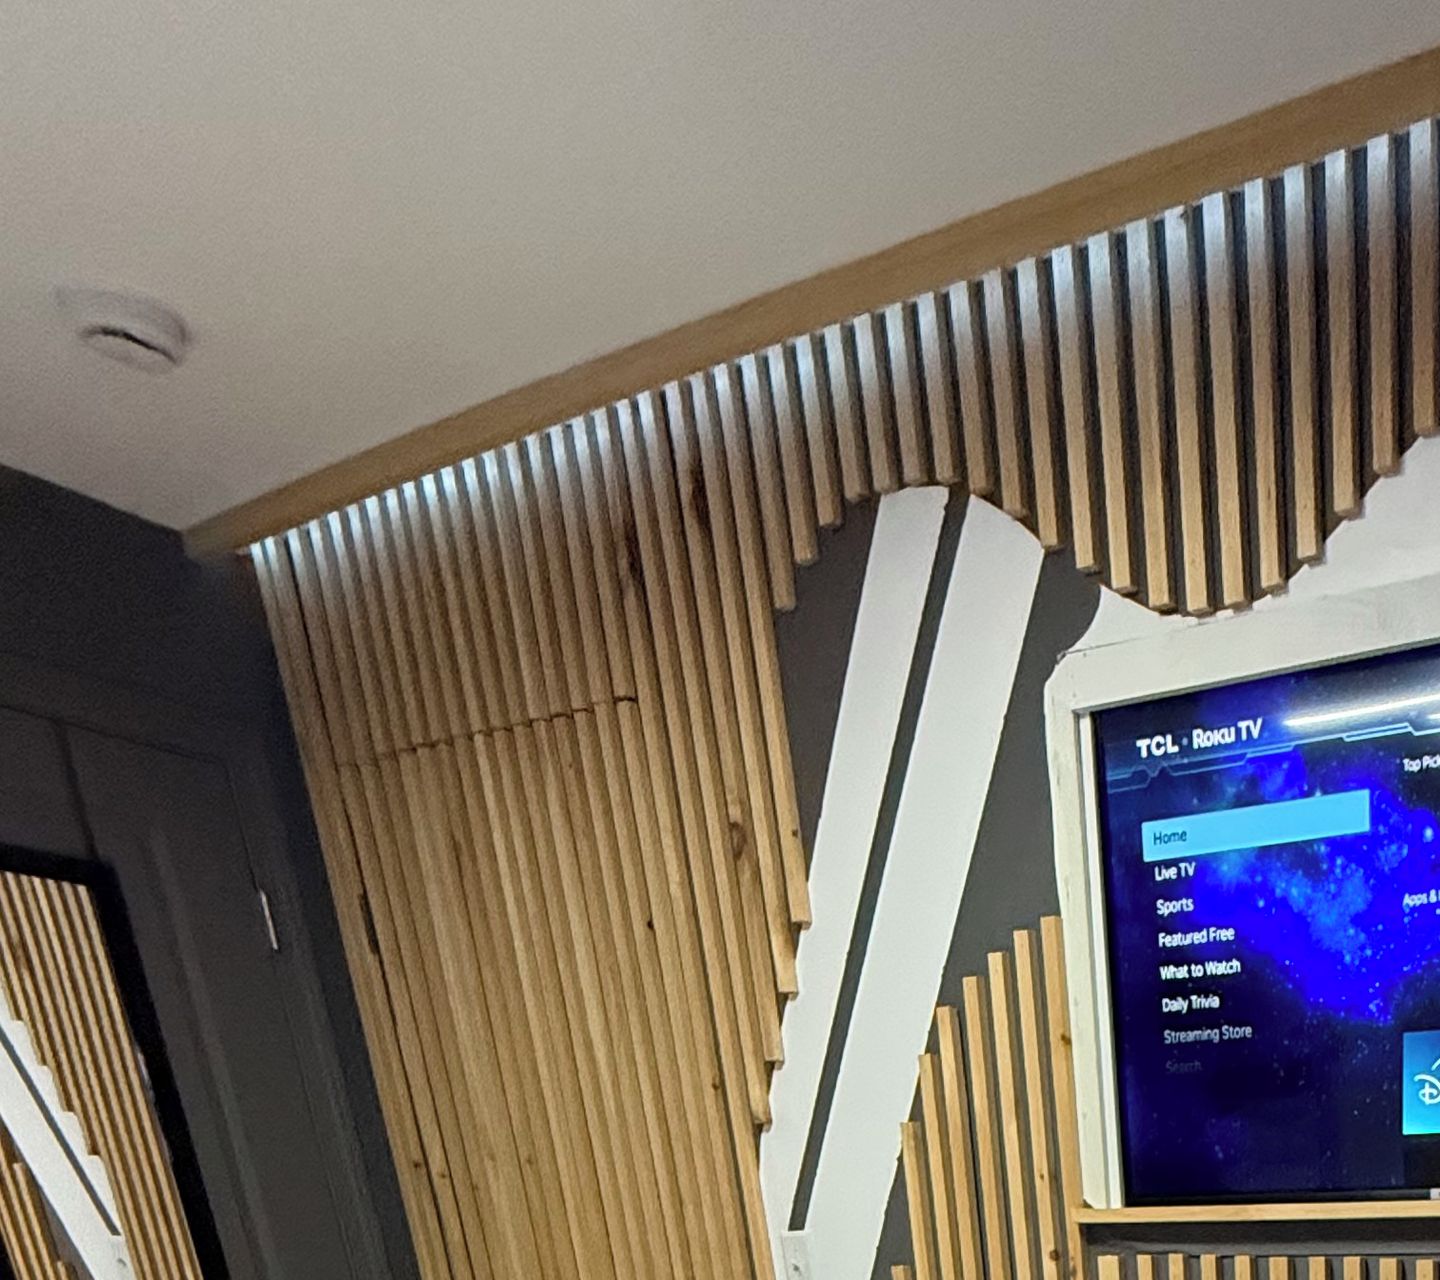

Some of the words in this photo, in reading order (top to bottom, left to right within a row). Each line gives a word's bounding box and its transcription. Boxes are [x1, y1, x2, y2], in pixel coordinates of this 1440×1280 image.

[1237, 717, 1262, 741] TV
[1136, 733, 1179, 758] TCL
[1403, 757, 1421, 773] Top
[1153, 830, 1187, 846] Home
[1154, 866, 1177, 881] Live
[1179, 862, 1196, 878] TV
[1156, 898, 1194, 916] Sports
[1403, 892, 1428, 907] Apps
[1158, 928, 1208, 948] Featured
[1209, 926, 1235, 942] Free
[1159, 964, 1189, 981] What
[1190, 963, 1204, 977] to
[1204, 957, 1241, 976] Watch
[1161, 996, 1189, 1014] Daily
[1189, 993, 1220, 1010] Trivia
[1163, 1026, 1220, 1044] Streaming
[1221, 1024, 1253, 1040] Store
